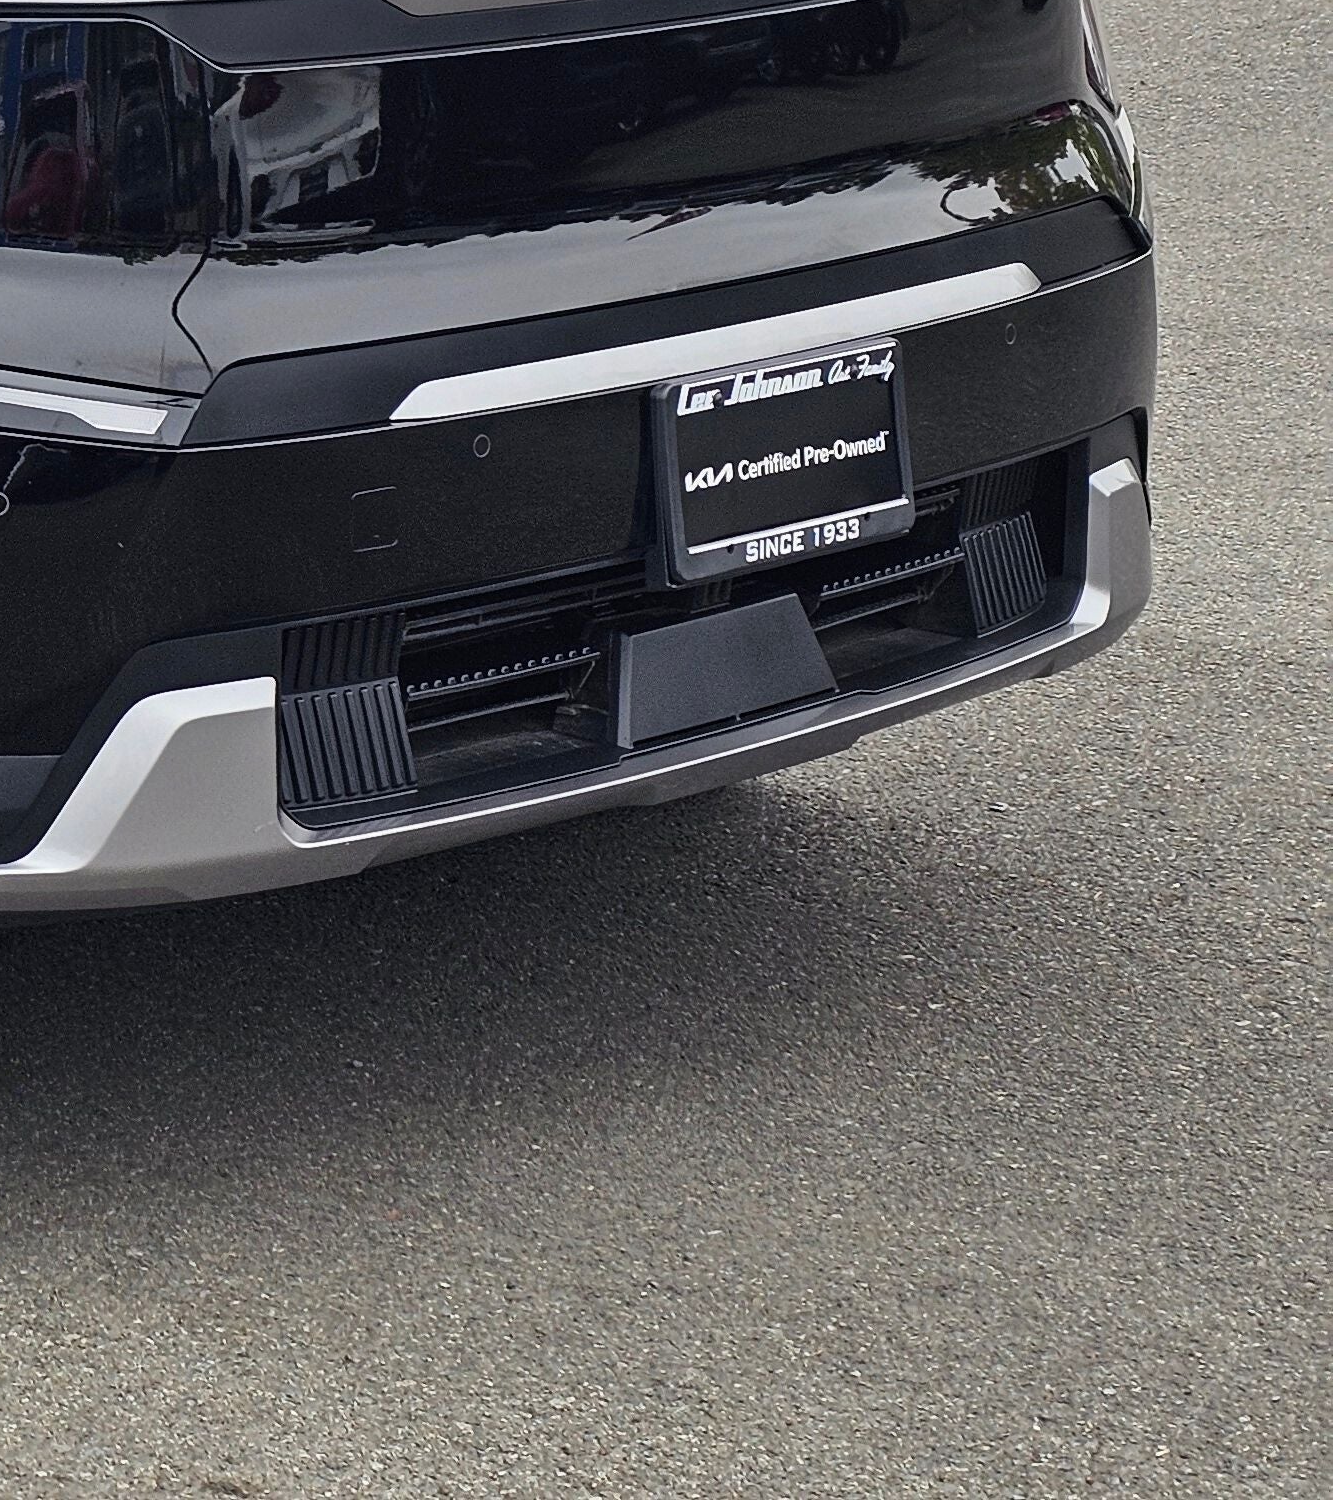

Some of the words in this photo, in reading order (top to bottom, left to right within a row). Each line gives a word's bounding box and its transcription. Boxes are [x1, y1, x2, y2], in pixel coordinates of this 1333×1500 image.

[724, 368, 824, 407] Johnson
[685, 463, 734, 492] KIA
[738, 449, 802, 481] Certified
[745, 530, 805, 563] SINCE
[812, 518, 861, 547] 1933
